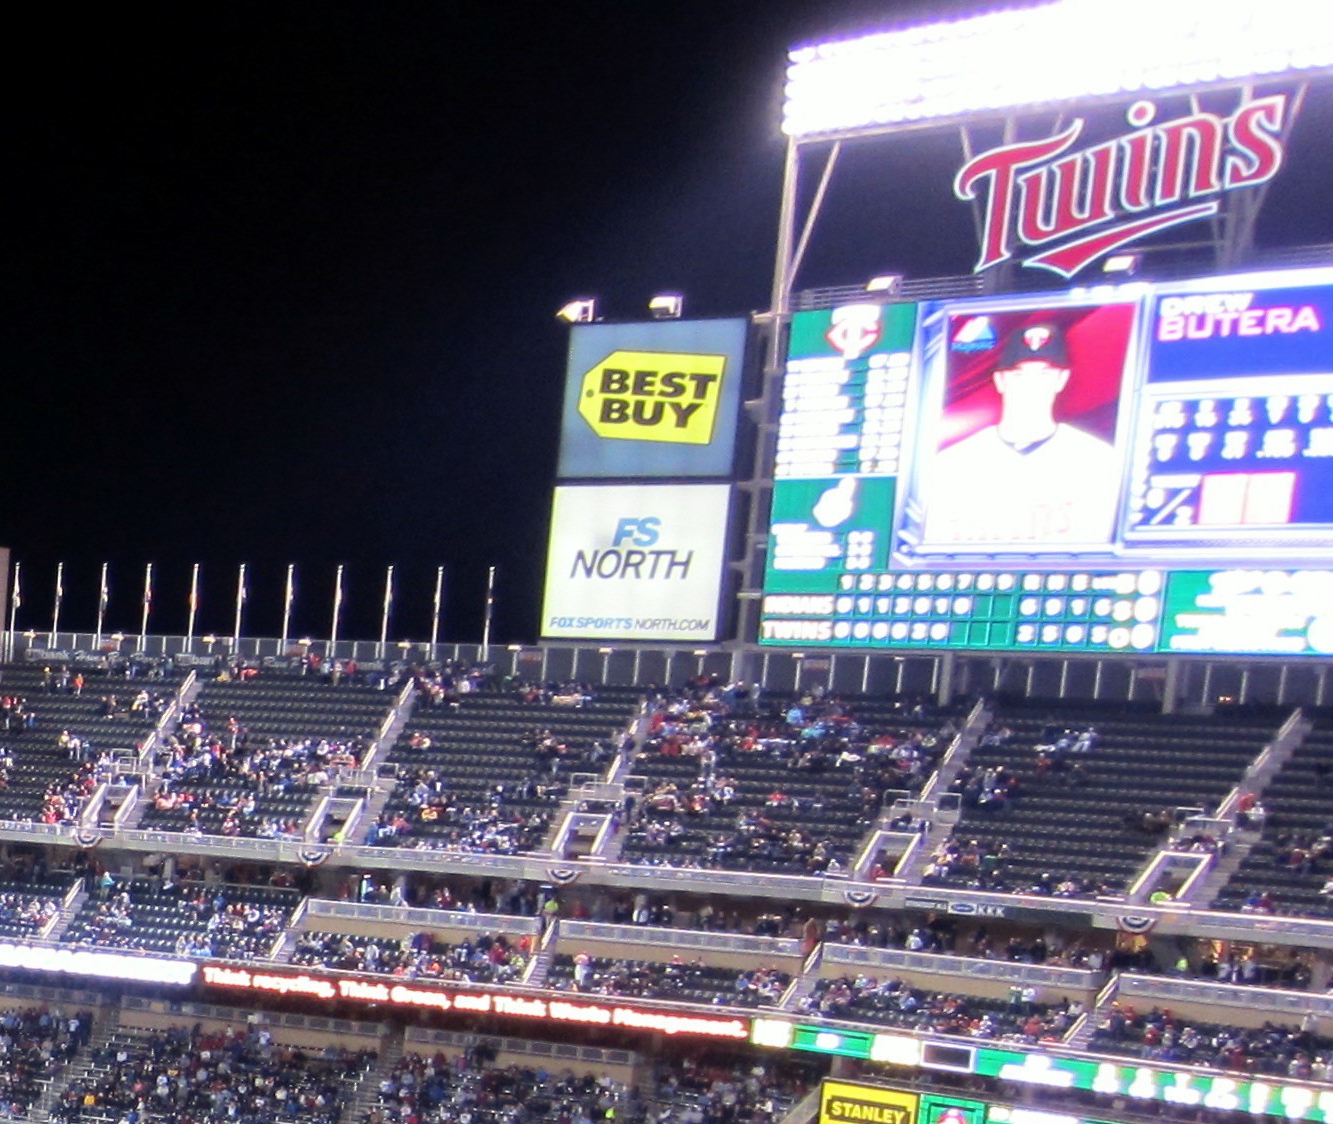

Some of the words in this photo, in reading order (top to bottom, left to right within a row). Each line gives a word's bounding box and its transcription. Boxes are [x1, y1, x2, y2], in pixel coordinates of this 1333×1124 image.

[953, 94, 1286, 273] Twins
[1158, 306, 1321, 341] BUTERA
[598, 367, 718, 400] BEST
[599, 397, 705, 429] BUY
[612, 517, 662, 548] FS
[569, 549, 694, 580] NORTH
[762, 619, 832, 639] TWINS
[203, 966, 250, 986] Think
[339, 979, 388, 1001] Think
[453, 994, 490, 1011] and
[493, 995, 546, 1017] Think
